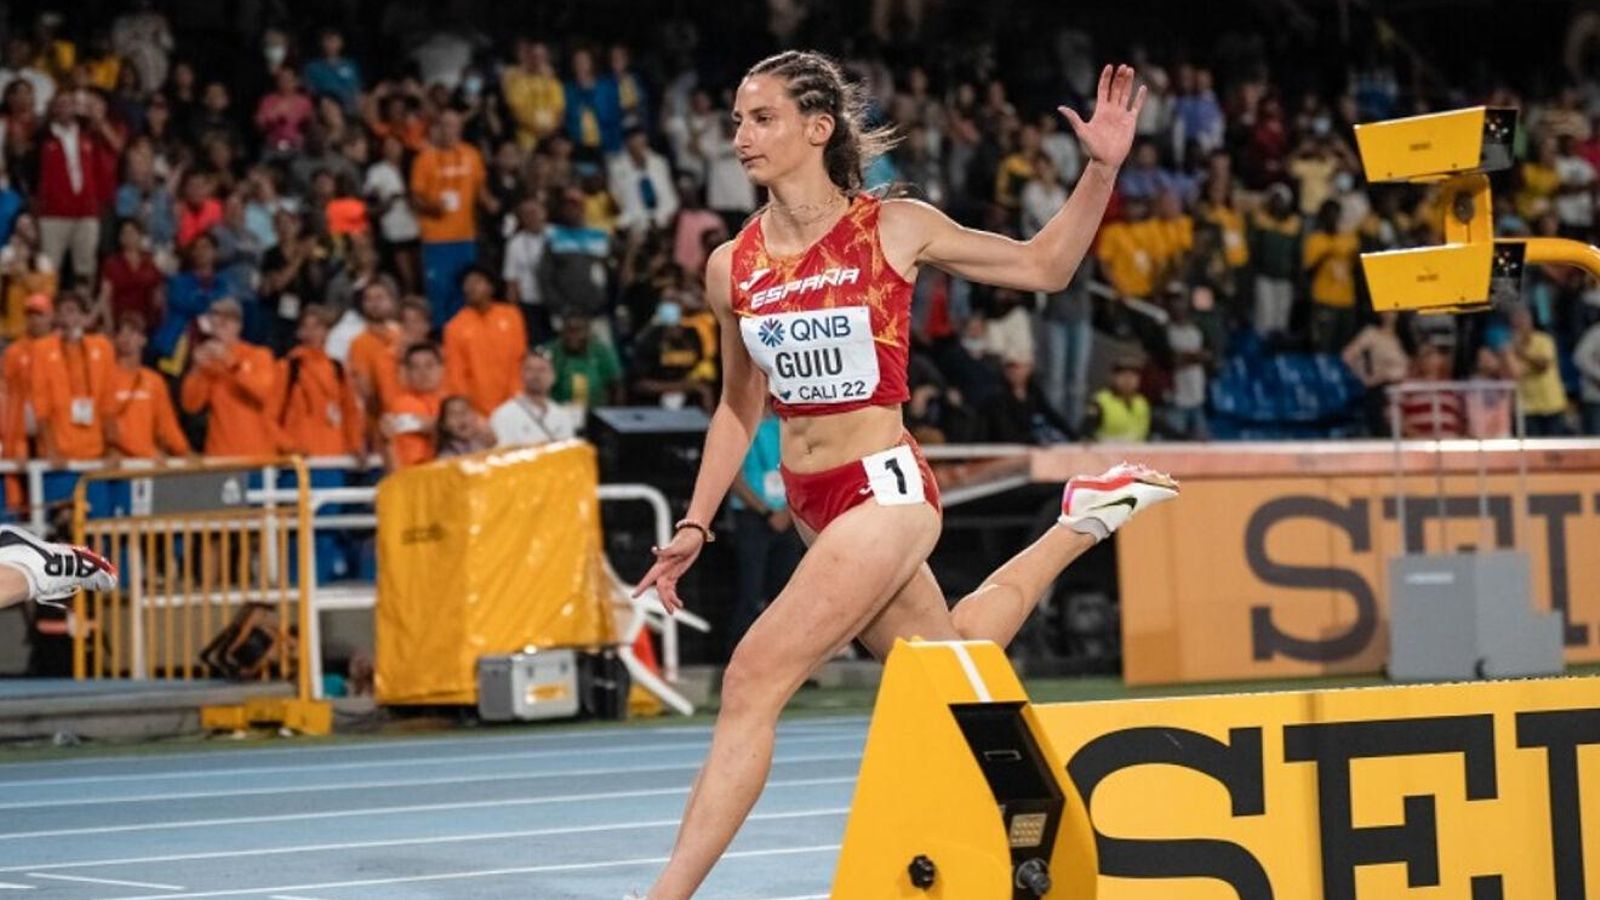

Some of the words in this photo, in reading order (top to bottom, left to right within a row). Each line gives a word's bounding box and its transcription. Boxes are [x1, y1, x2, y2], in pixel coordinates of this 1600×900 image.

[751, 267, 860, 309] ESPAÑA
[790, 316, 851, 341] QNB
[775, 347, 843, 378] GUIU
[799, 385, 837, 400] CALI
[841, 380, 867, 397] 22
[885, 457, 907, 494] 1
